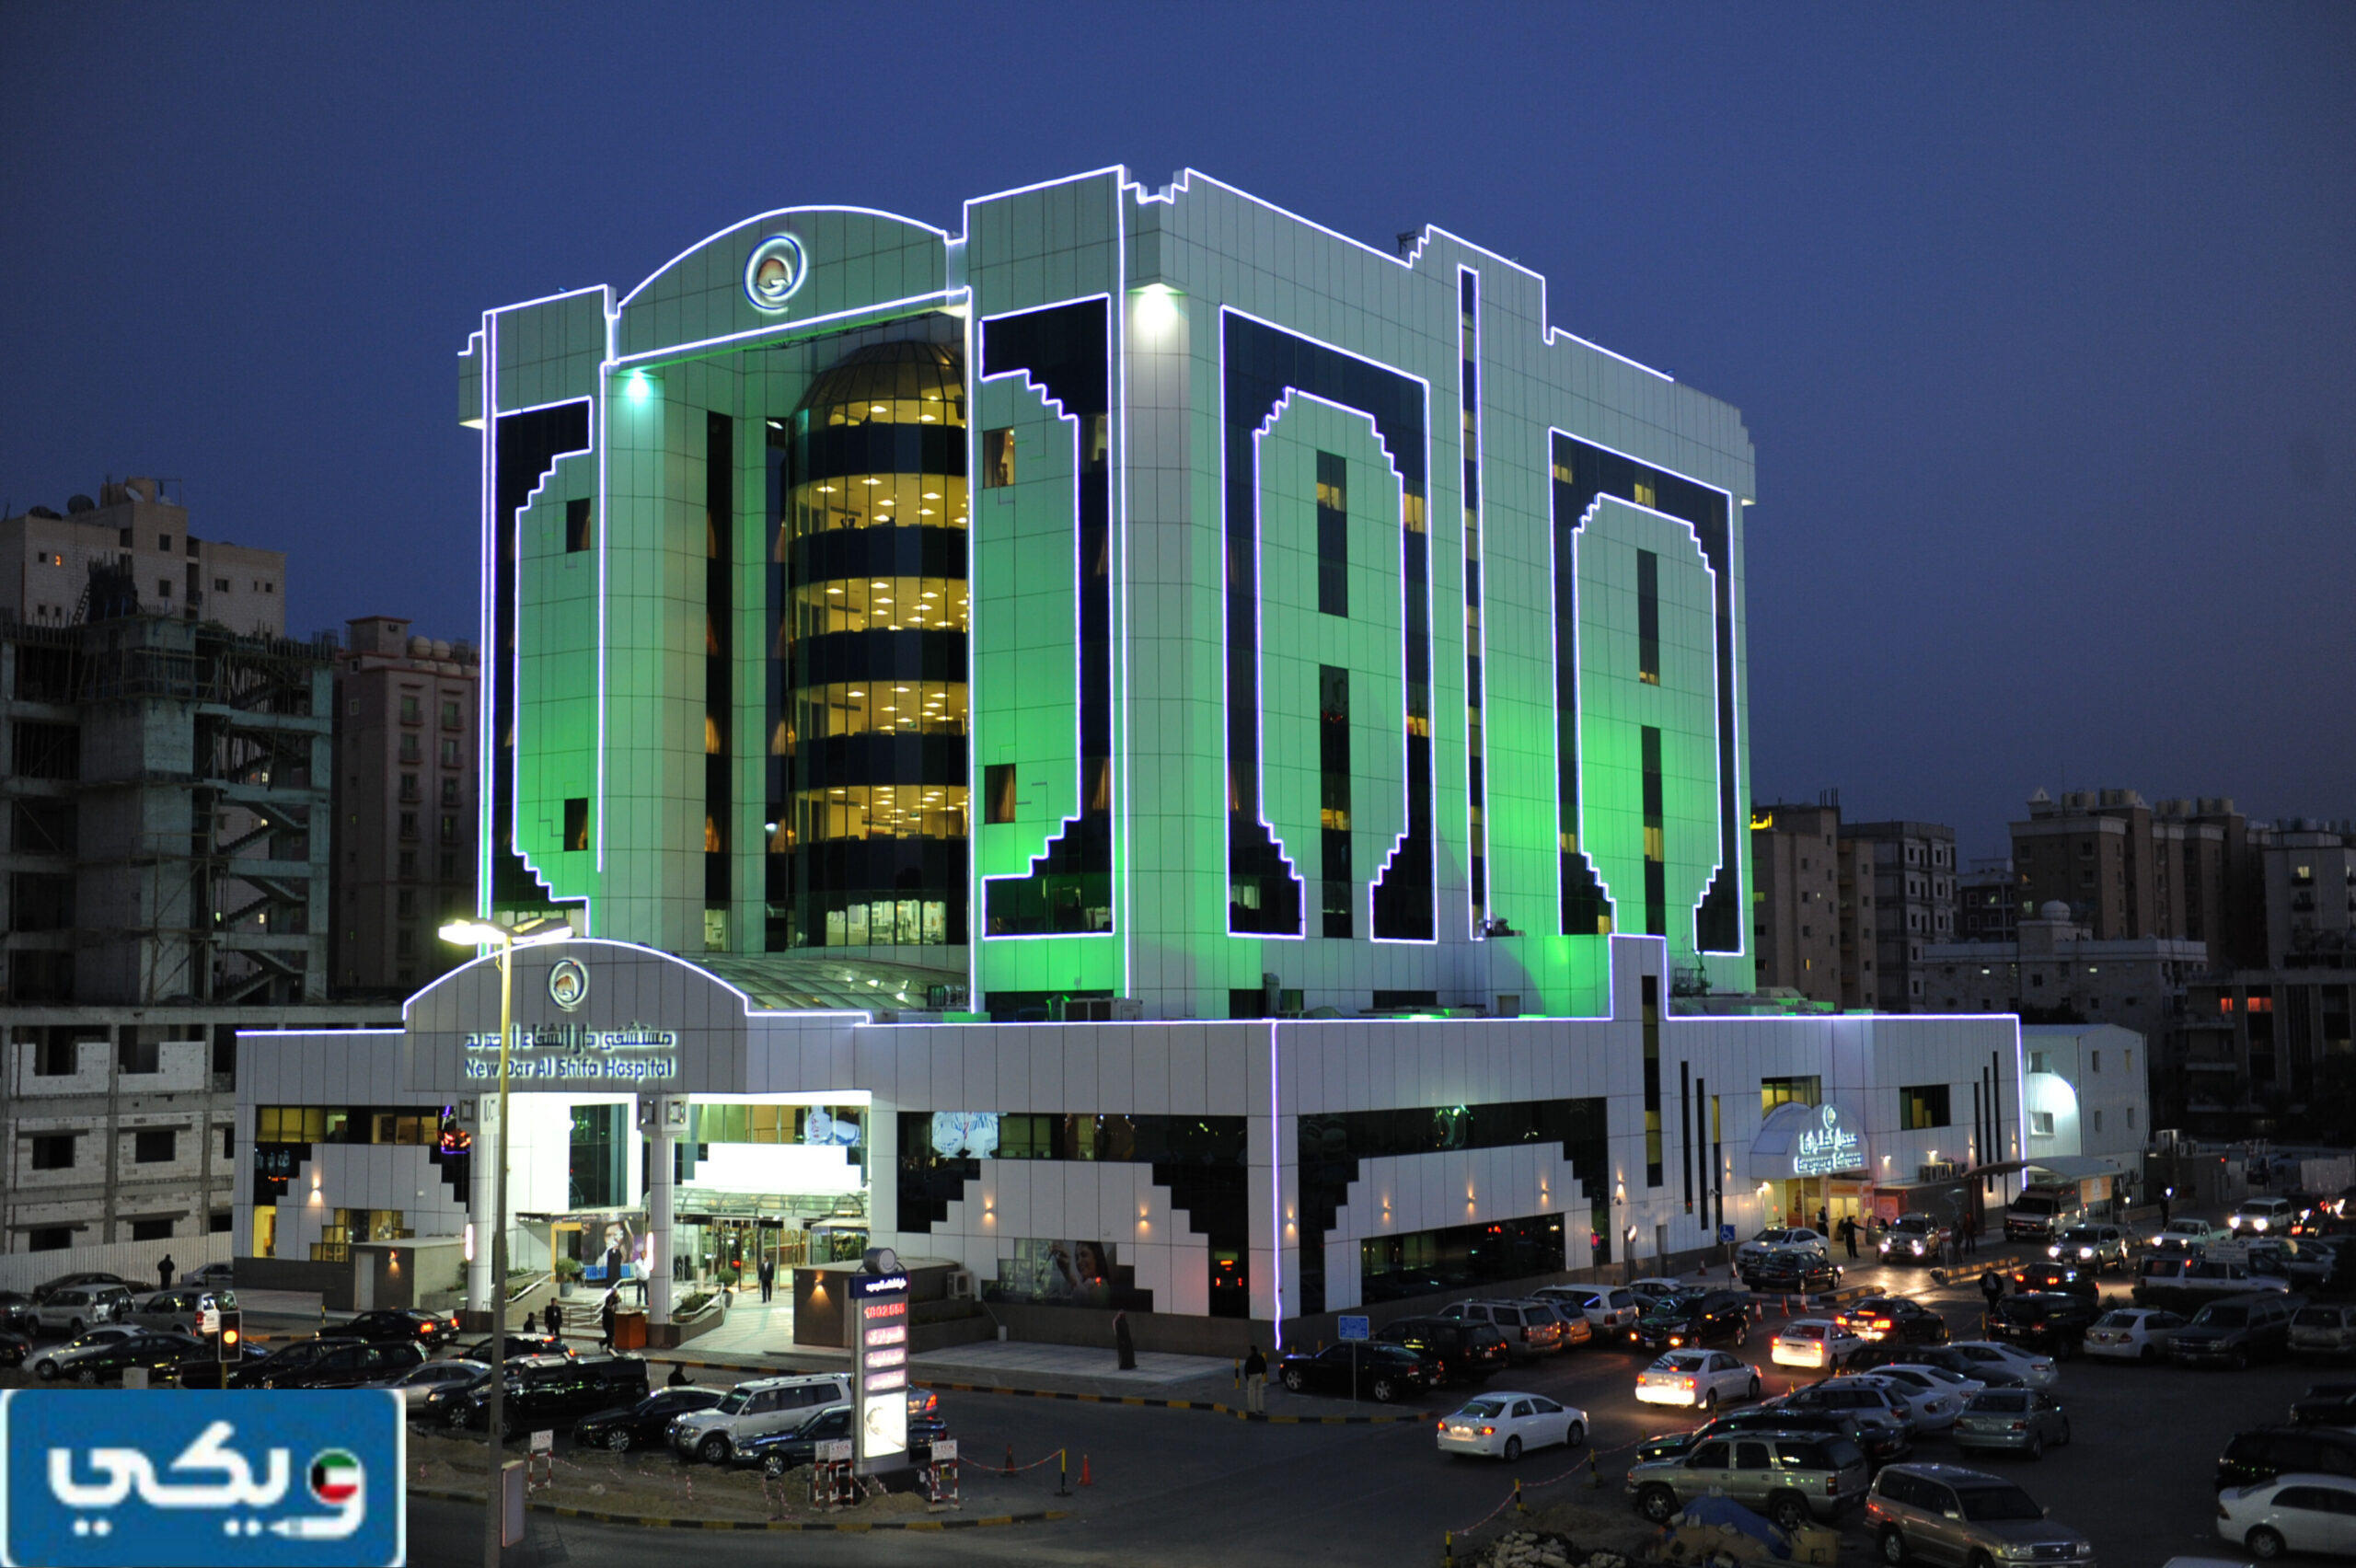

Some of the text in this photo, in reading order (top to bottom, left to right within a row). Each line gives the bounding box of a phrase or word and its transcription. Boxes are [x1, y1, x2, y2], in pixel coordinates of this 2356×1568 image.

[521, 1022, 572, 1049] الشفاء
[572, 1022, 598, 1055] دار
[599, 1019, 676, 1053] مستشفى
[464, 1056, 676, 1083] New Dar Al Shifa Hospital
